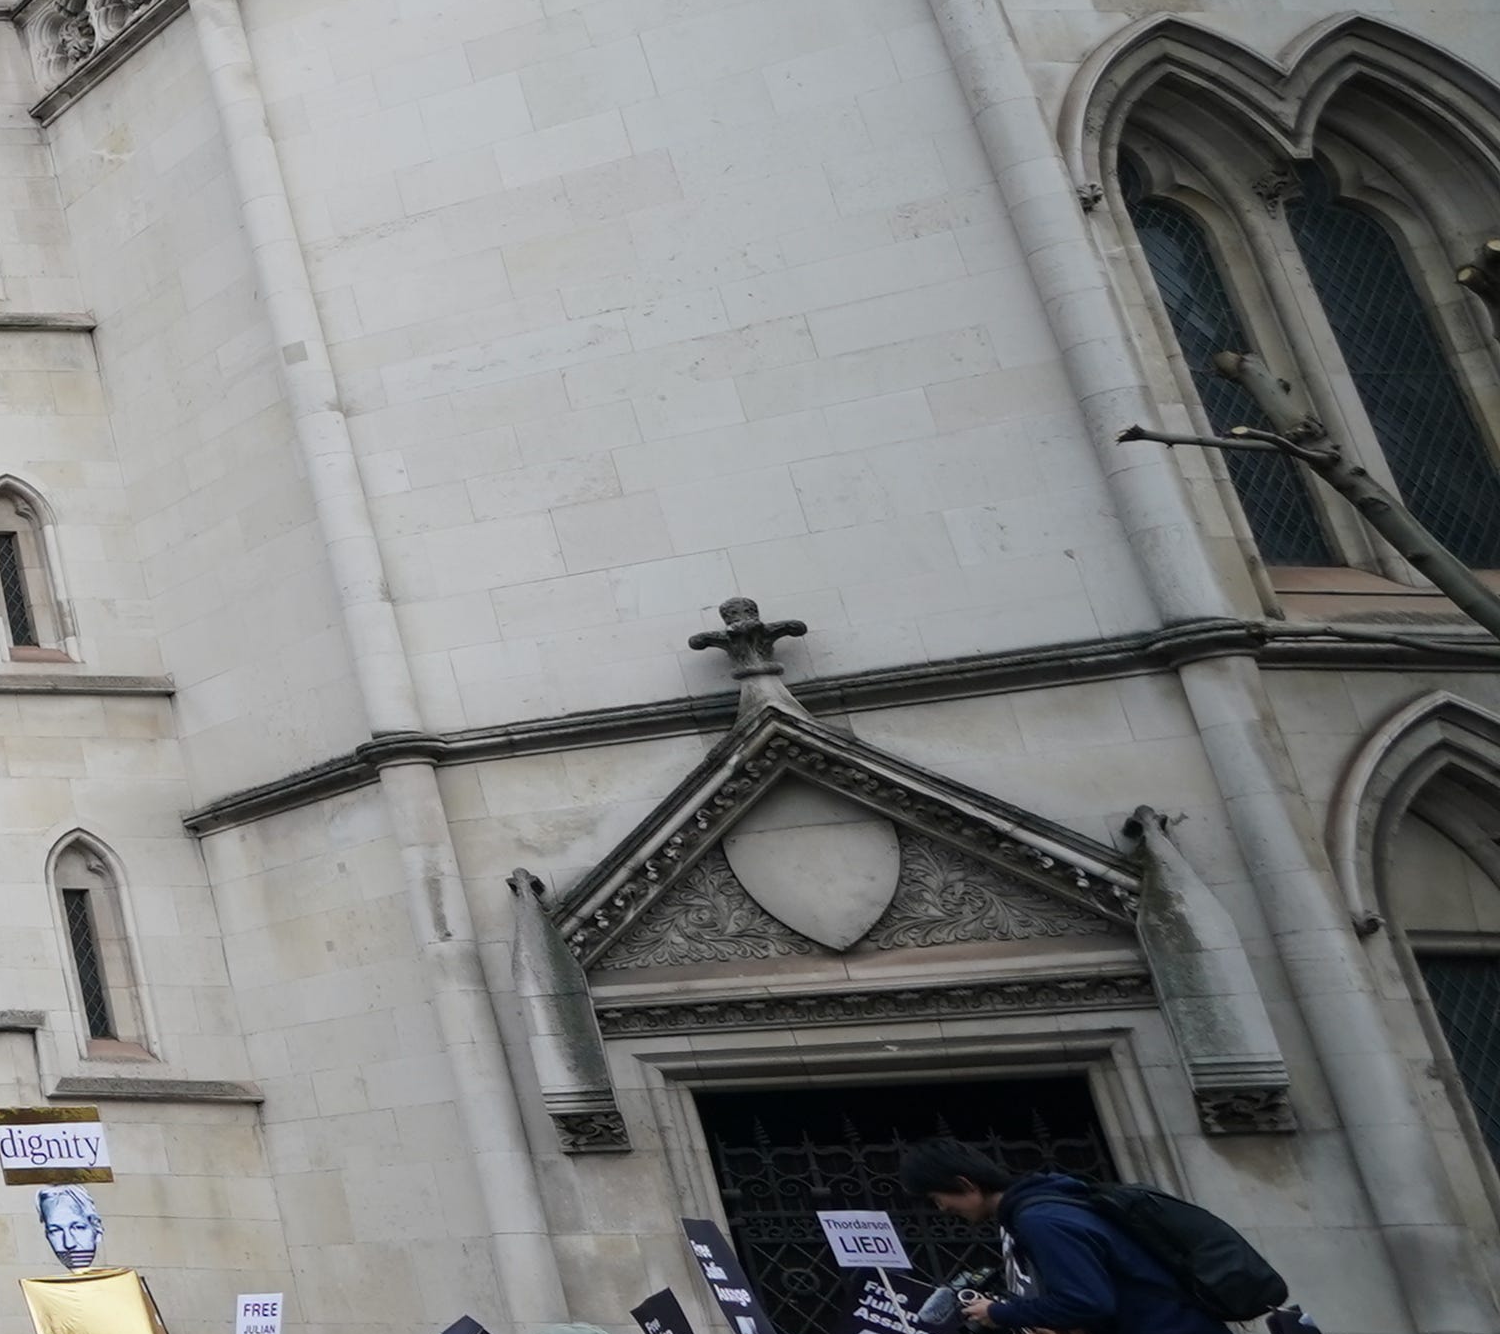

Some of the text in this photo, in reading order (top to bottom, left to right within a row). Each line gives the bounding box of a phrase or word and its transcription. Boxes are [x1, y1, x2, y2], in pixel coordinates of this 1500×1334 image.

[0, 1128, 100, 1166] dignity
[824, 1218, 891, 1231] Thordarson
[838, 1236, 896, 1255] LIED!
[243, 1302, 278, 1317] FREE
[244, 1325, 276, 1334] JULIAN
